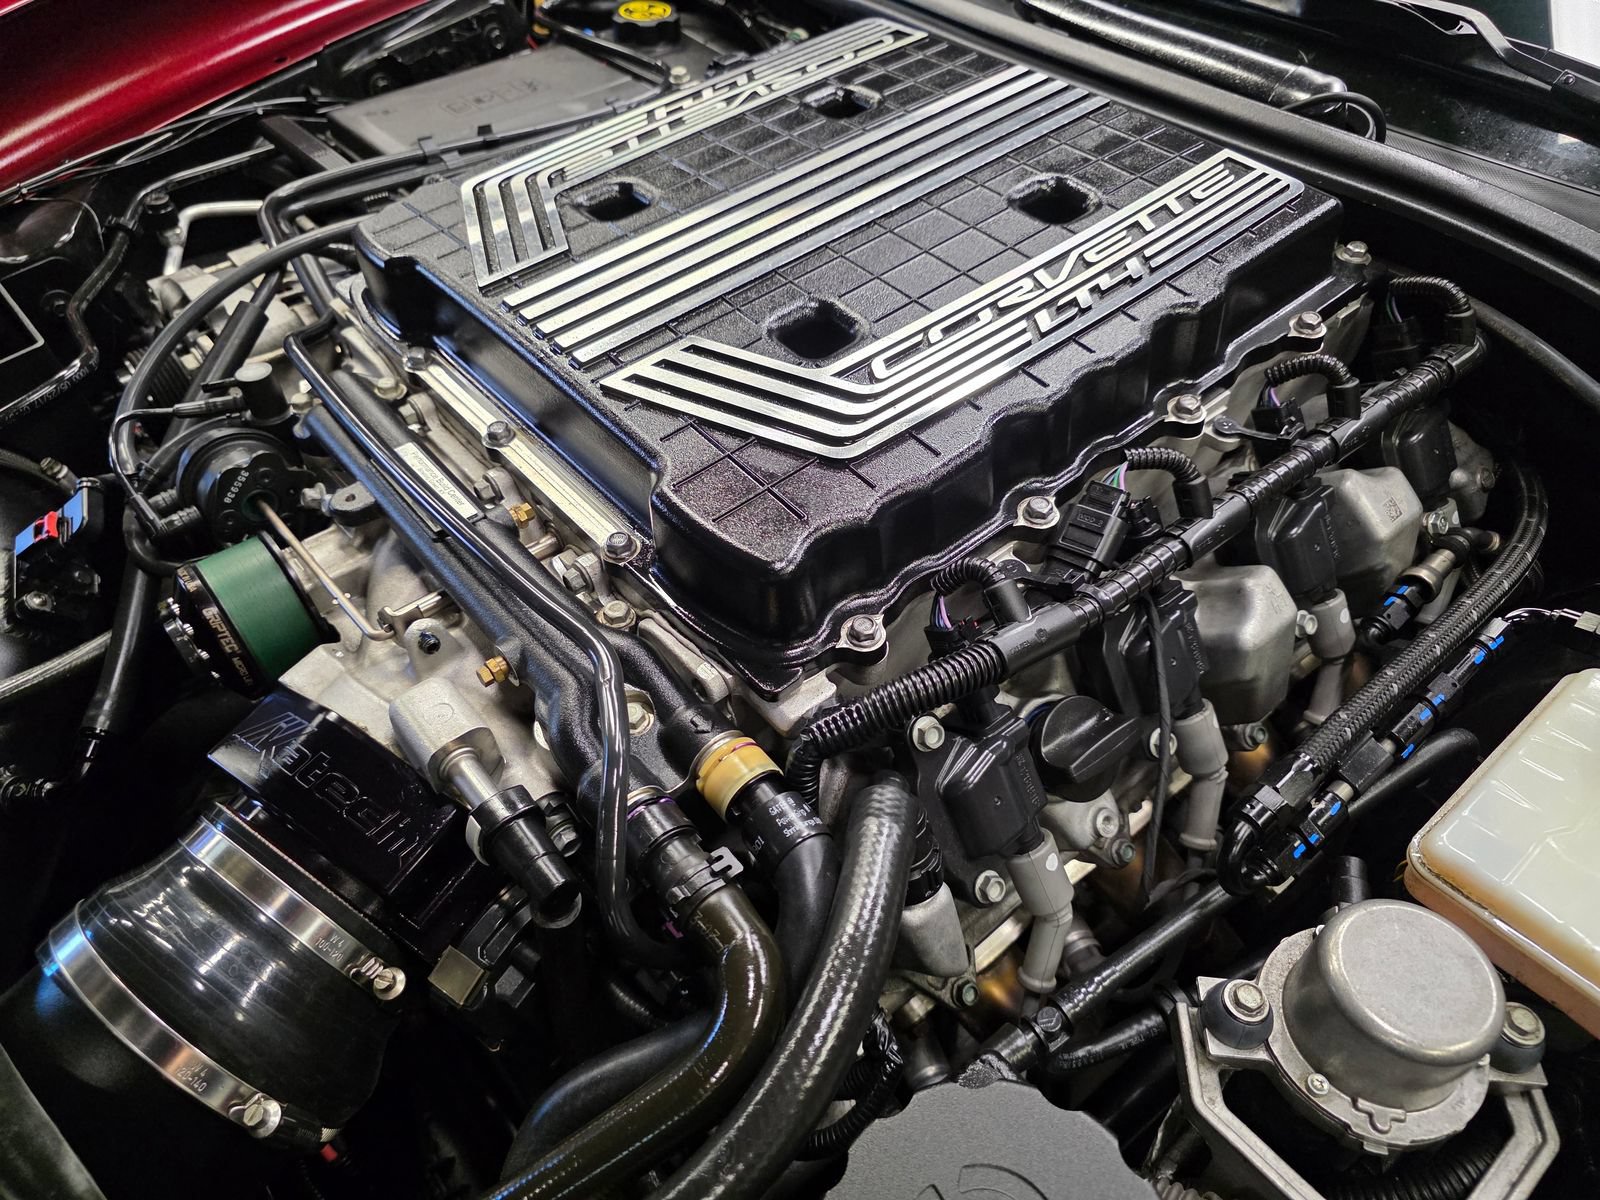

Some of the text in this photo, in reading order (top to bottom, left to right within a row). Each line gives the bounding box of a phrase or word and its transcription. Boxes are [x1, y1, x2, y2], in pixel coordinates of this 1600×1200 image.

[565, 35, 894, 180] CORVETTE
[871, 163, 1235, 380] CORVETTE
[1034, 257, 1145, 333] LT4
